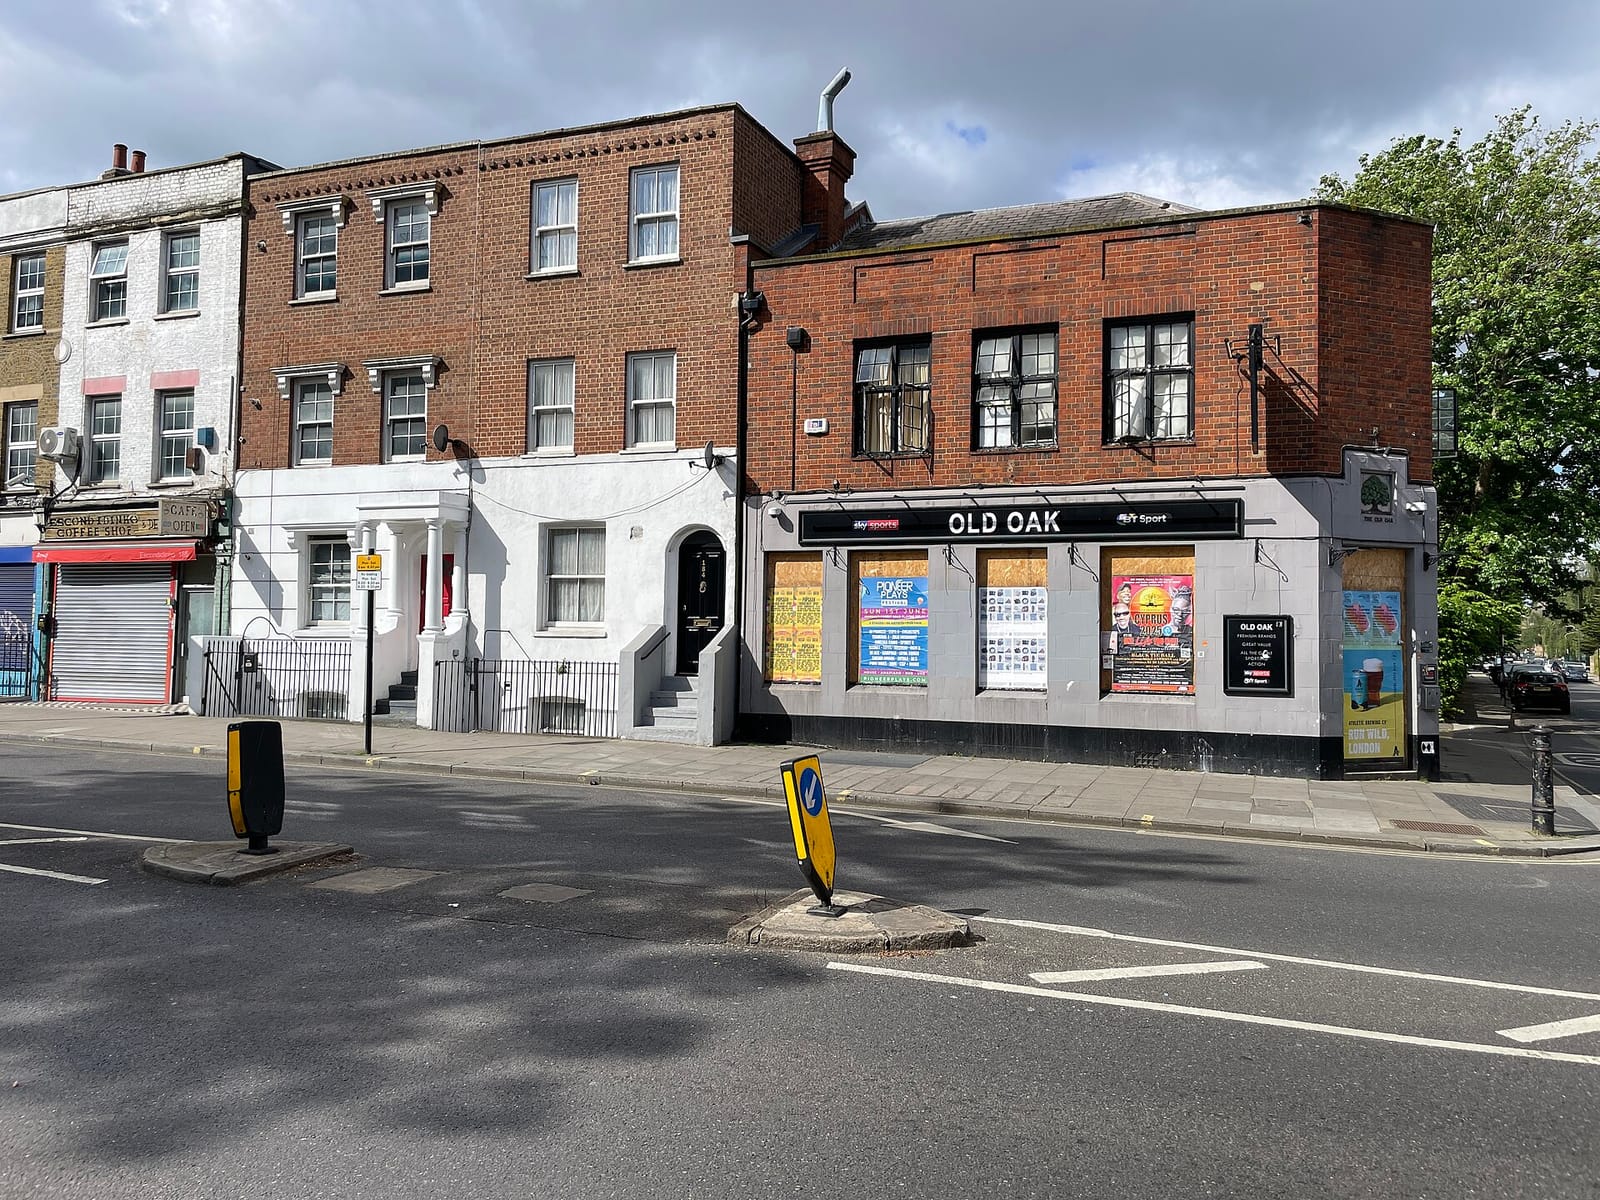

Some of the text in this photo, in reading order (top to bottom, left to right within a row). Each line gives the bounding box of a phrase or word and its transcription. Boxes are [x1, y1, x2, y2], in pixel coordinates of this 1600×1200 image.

[170, 504, 197, 517] CAFE
[948, 510, 1060, 534] OLD OAK
[1140, 514, 1166, 524] Sport
[173, 520, 196, 532] OPEN
[854, 521, 897, 530] sky sports
[56, 526, 132, 538] COFFEE SHOP
[876, 580, 913, 592] PIONEER
[1134, 614, 1168, 624] CYPRUS
[1140, 626, 1162, 636] 2025
[1348, 728, 1390, 740] RUN WILD,
[1348, 743, 1380, 754] LONDON
